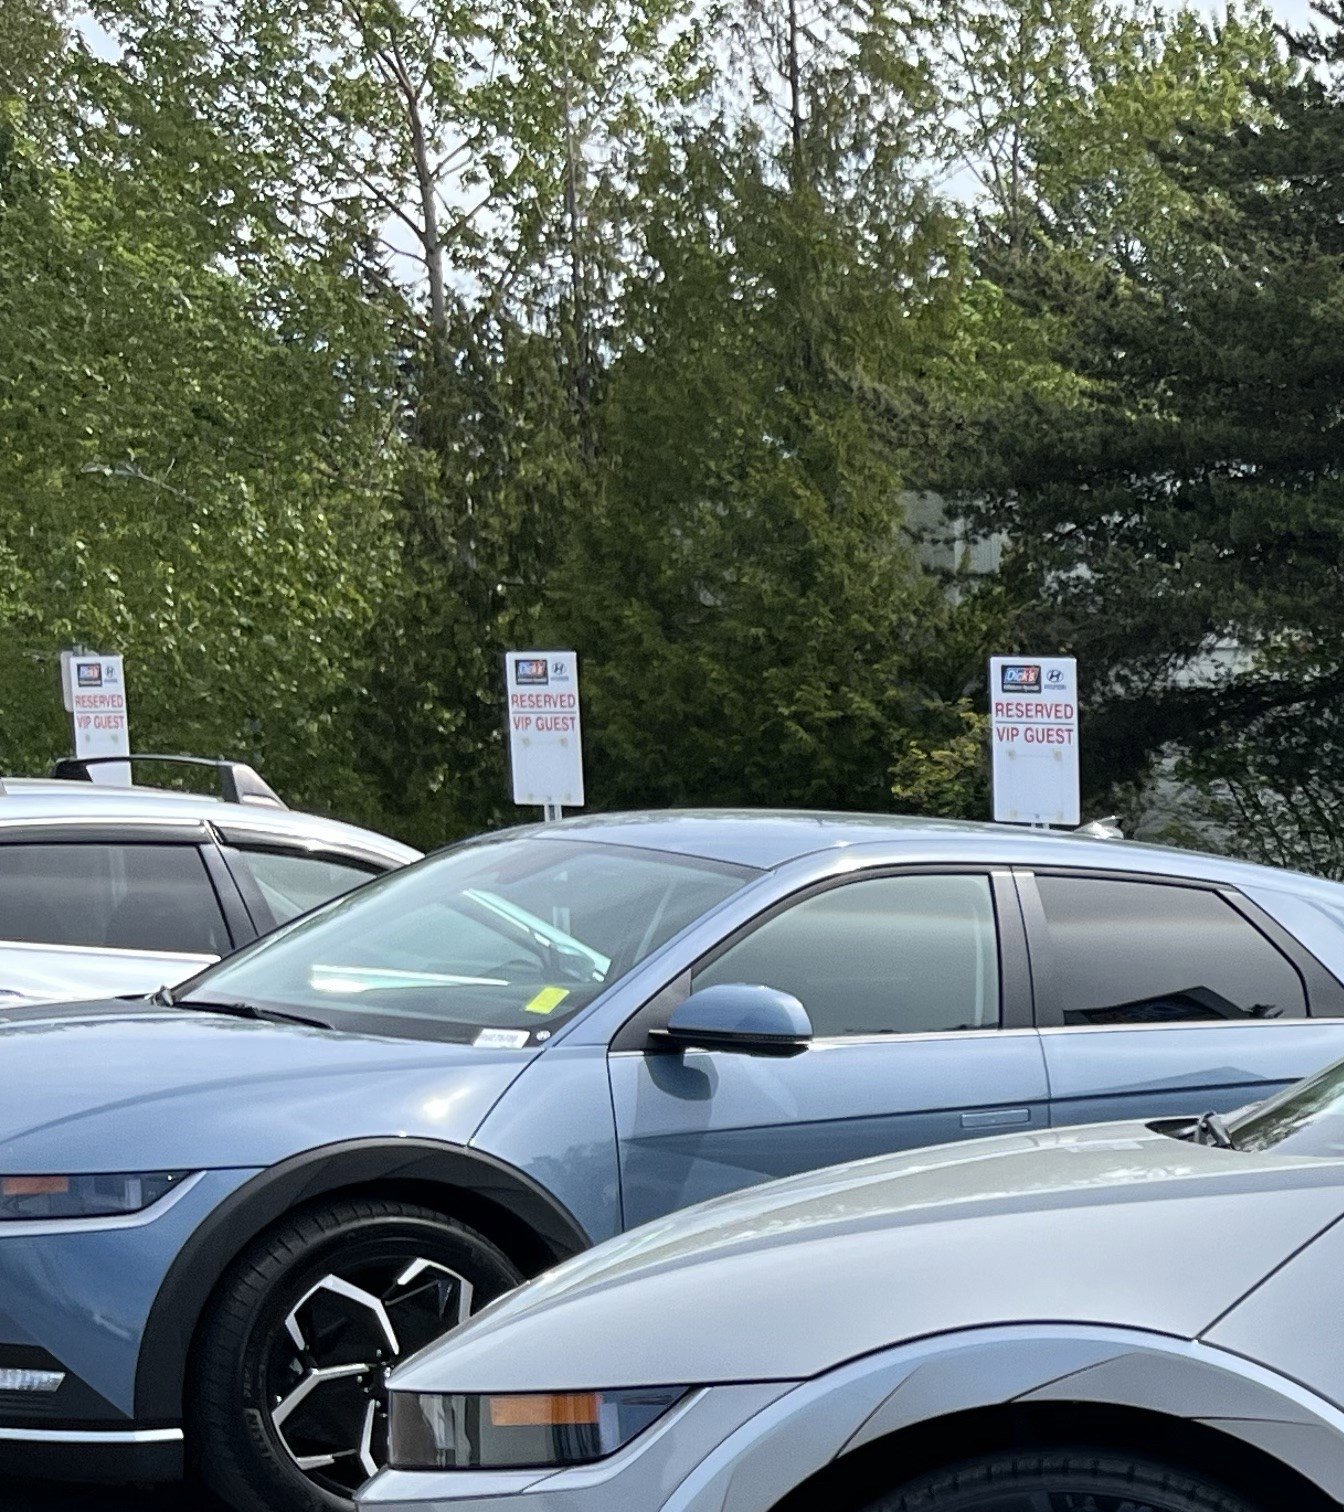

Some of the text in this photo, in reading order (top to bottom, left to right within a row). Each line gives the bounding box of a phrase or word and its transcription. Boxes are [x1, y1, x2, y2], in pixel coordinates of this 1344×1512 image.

[75, 694, 124, 709] RESERVED
[511, 694, 576, 709] RESERVED
[995, 703, 1074, 719] RESERVED
[76, 715, 124, 730] VIP GUEST
[513, 716, 576, 731] VIP GUEST
[996, 727, 1074, 744] VIP GUEST
